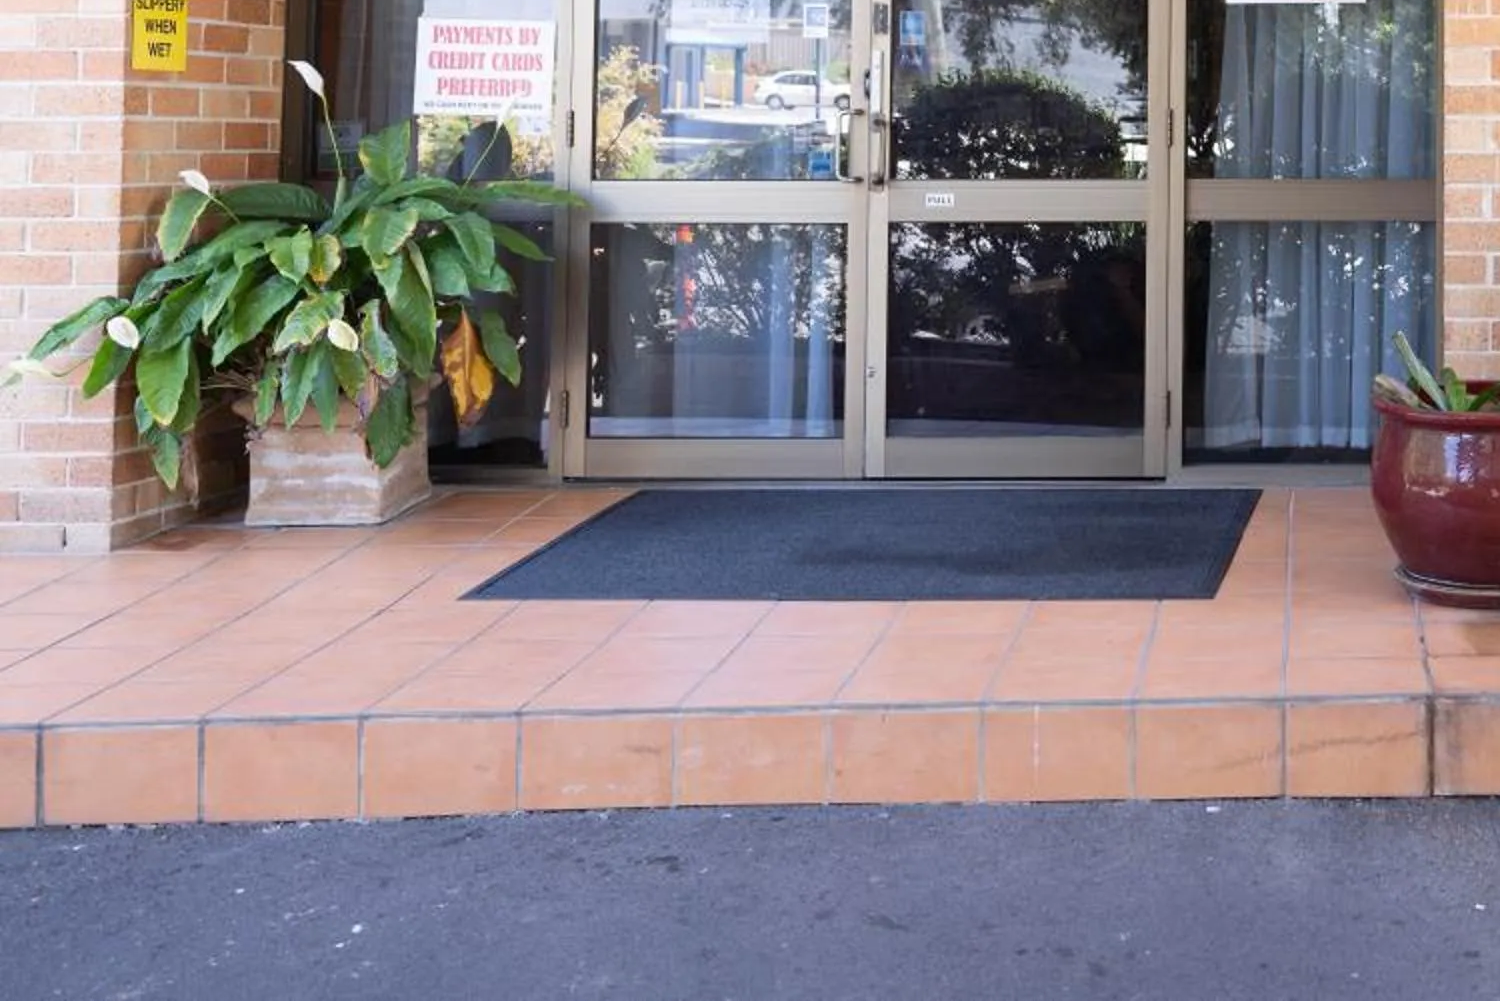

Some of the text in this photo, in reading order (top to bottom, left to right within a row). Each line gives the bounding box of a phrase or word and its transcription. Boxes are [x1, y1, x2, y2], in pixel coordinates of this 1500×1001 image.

[145, 18, 177, 35] WHEN
[432, 25, 542, 45] PAYMENTS BY
[147, 42, 172, 58] WET
[428, 50, 543, 72] CREDIT CARDS
